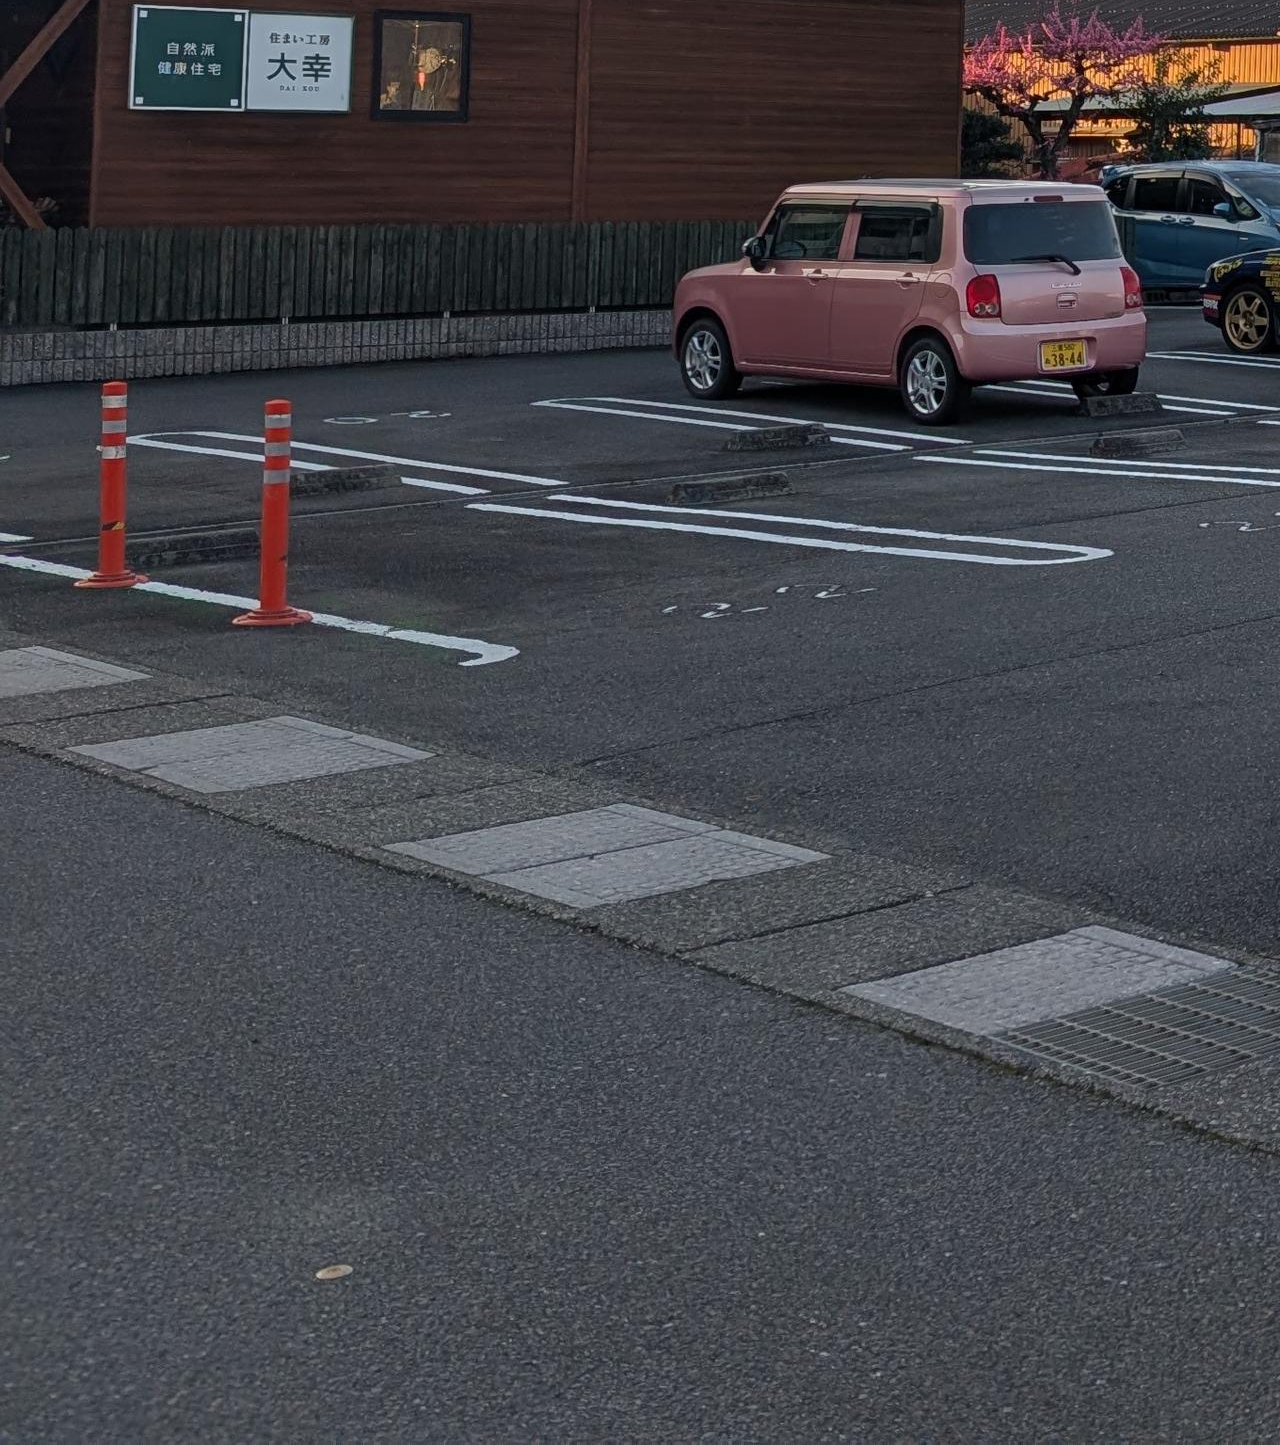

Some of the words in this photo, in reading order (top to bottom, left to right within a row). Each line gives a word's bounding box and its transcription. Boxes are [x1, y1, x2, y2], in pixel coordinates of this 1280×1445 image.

[269, 32, 331, 46] 住まい工房
[166, 42, 216, 57] 自然派
[158, 60, 222, 76] 健康住宅
[266, 52, 332, 83] 大幸
[1051, 352, 1082, 367] 38-44
